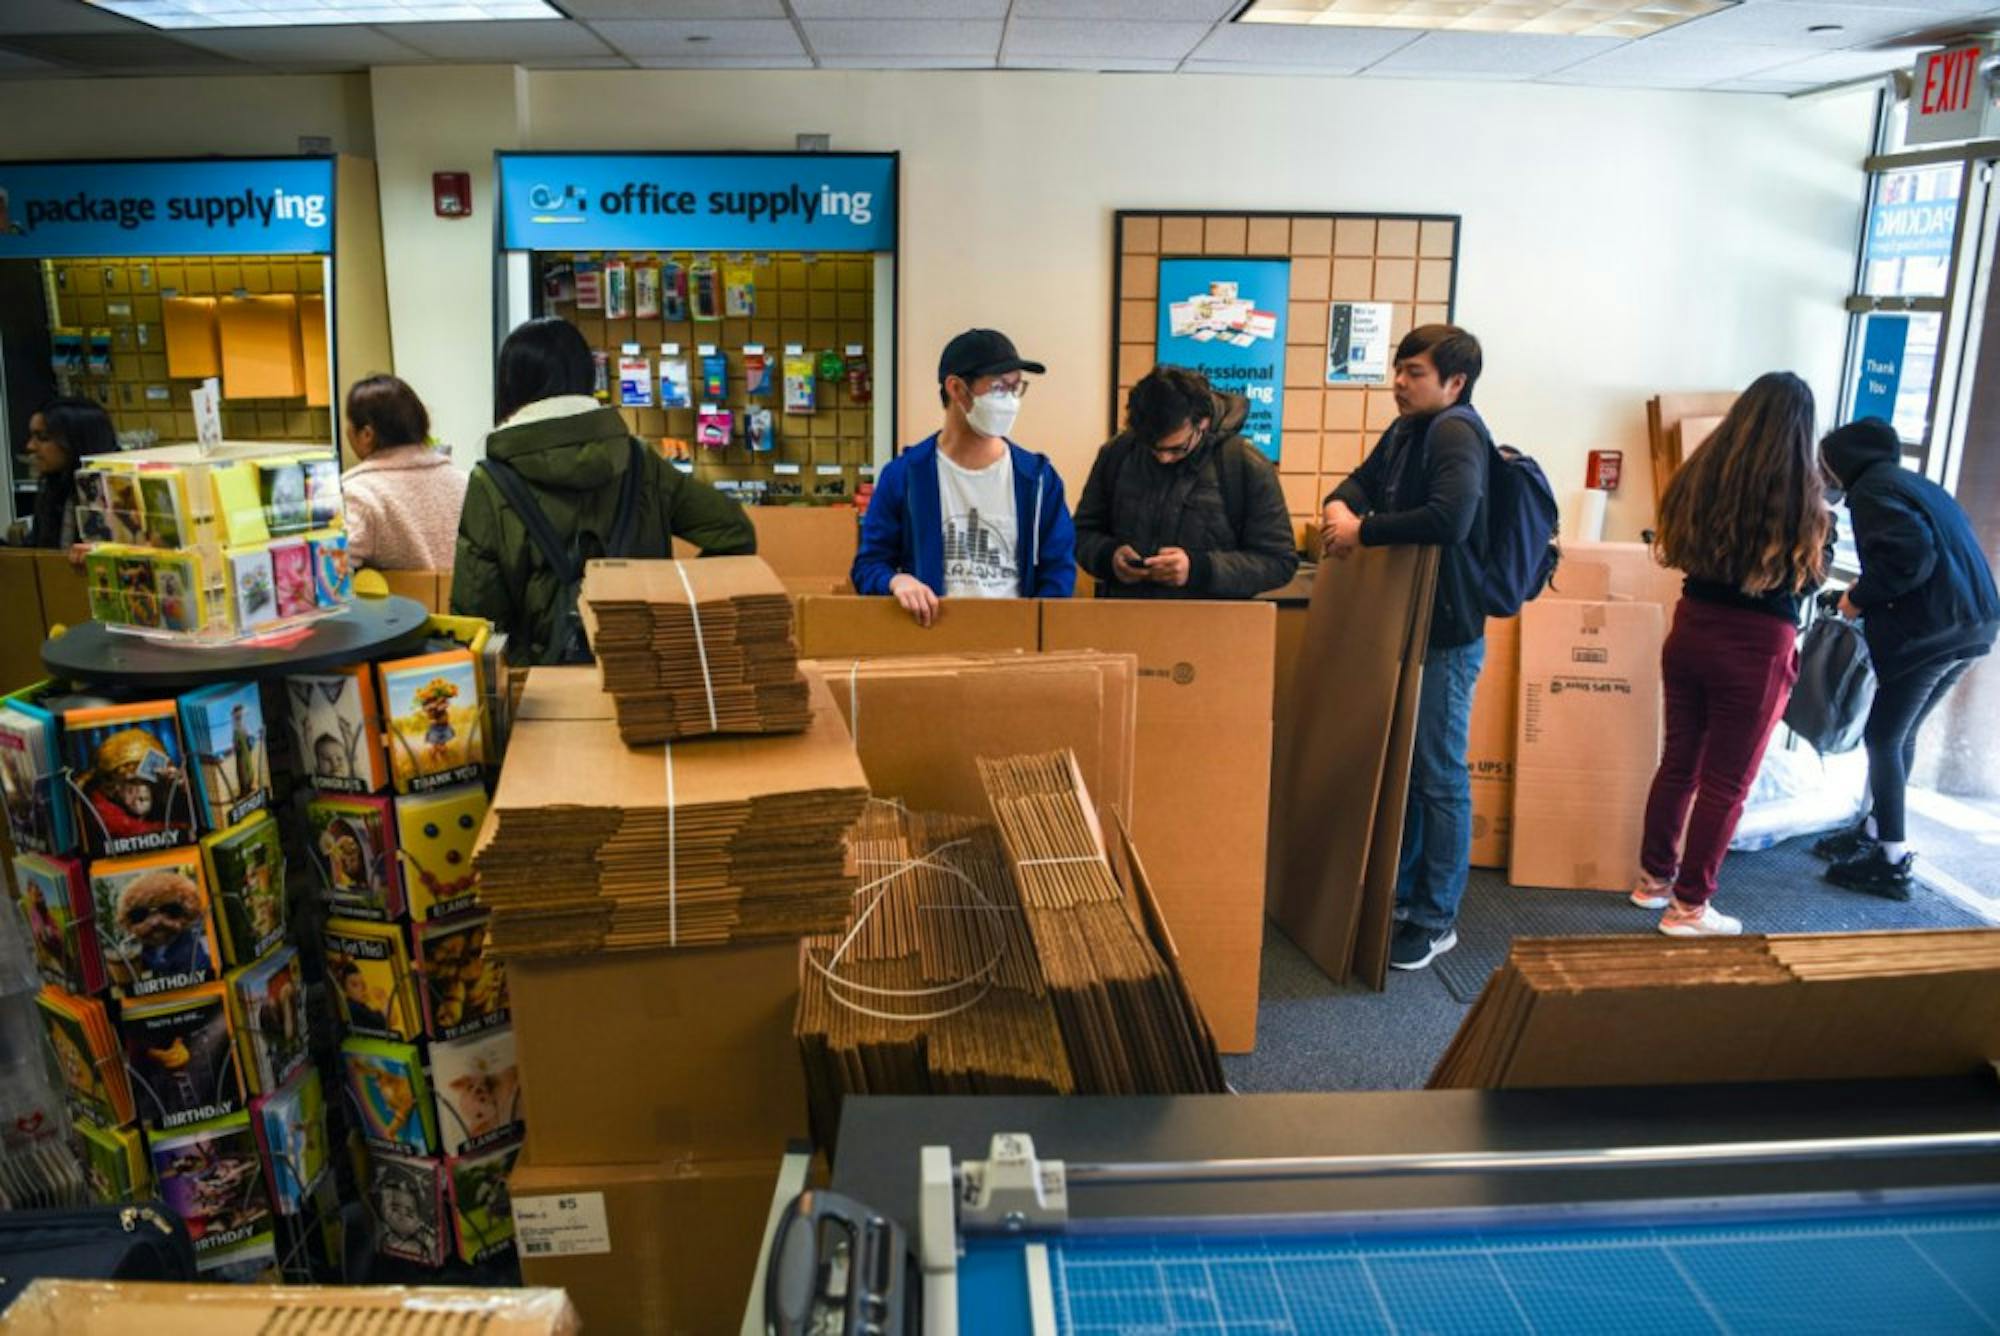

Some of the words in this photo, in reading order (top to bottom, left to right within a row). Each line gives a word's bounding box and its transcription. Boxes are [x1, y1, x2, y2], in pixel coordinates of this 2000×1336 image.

[1921, 47, 1980, 114] EXIT
[25, 191, 156, 228] package
[168, 188, 326, 227] supplying
[600, 183, 696, 215] office
[708, 183, 872, 224] supplying
[1867, 359, 1895, 374] Thank
[1869, 379, 1888, 395] You
[104, 829, 179, 856] BIRTHDAY
[132, 968, 206, 996] BIRTHDAY
[162, 1099, 231, 1128] BIRTHDAY
[194, 1224, 254, 1252] IRTHDAY
